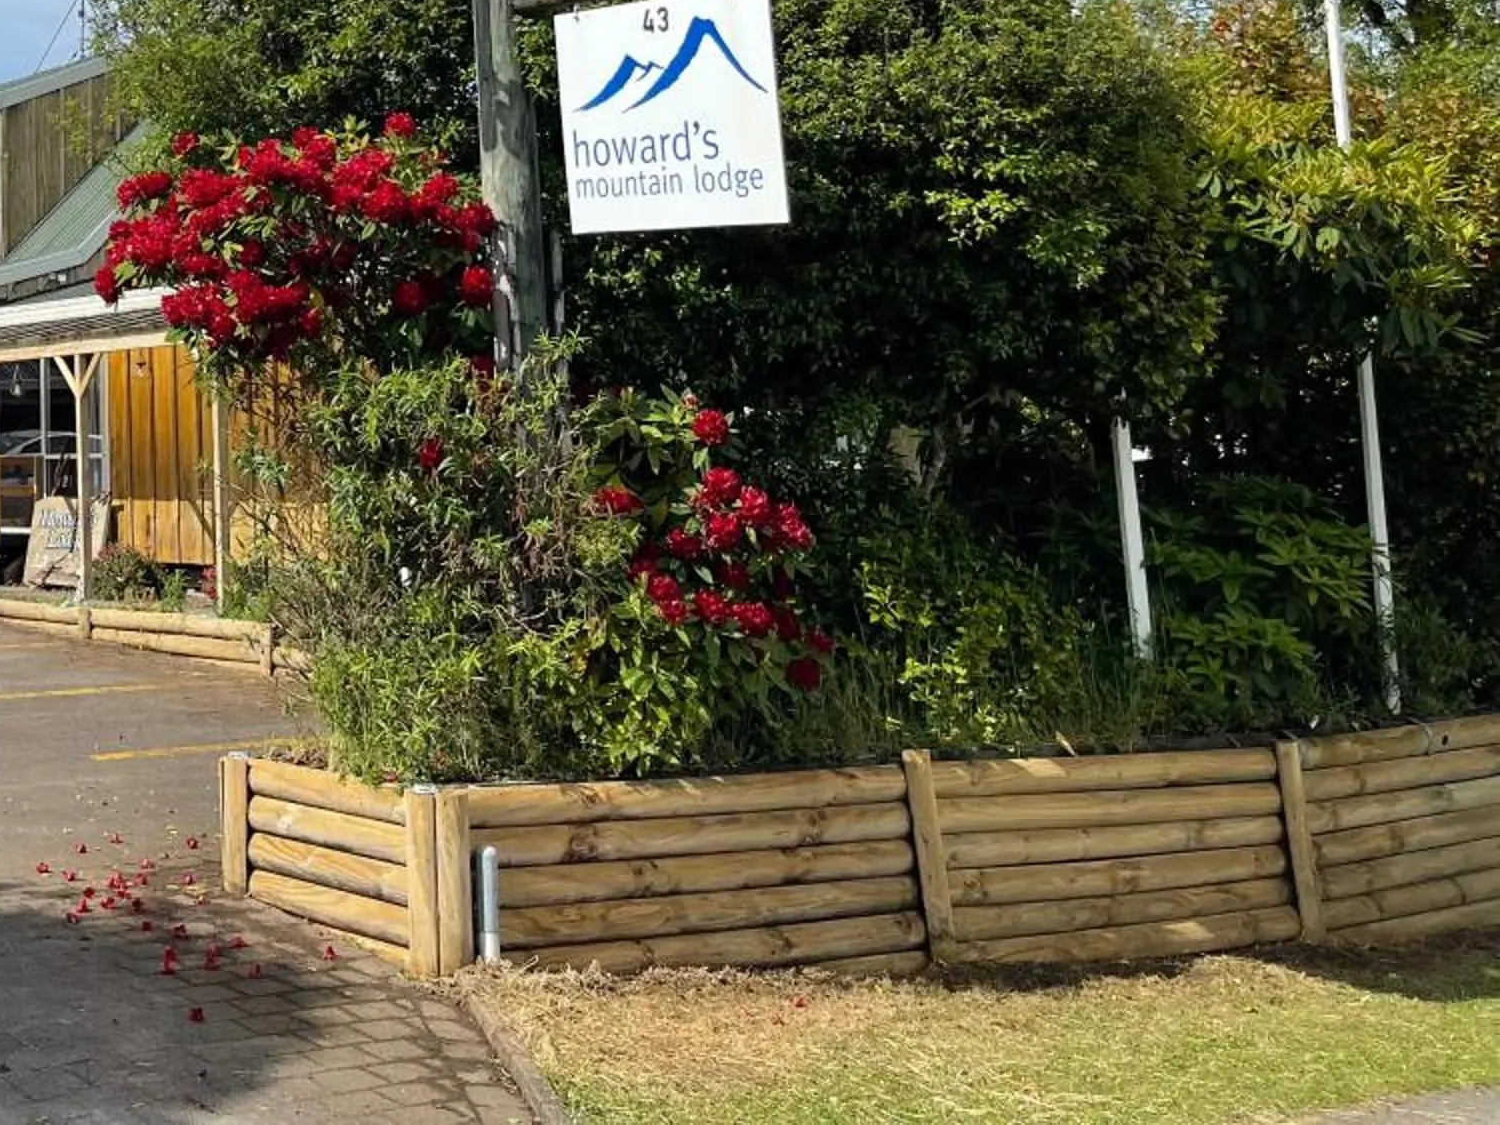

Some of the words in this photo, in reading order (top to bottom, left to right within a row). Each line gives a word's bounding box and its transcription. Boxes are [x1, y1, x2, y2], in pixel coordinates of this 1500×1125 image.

[642, 6, 669, 33] 43
[572, 120, 719, 167] howard's
[575, 166, 683, 199] mountain
[693, 162, 764, 198] lodge
